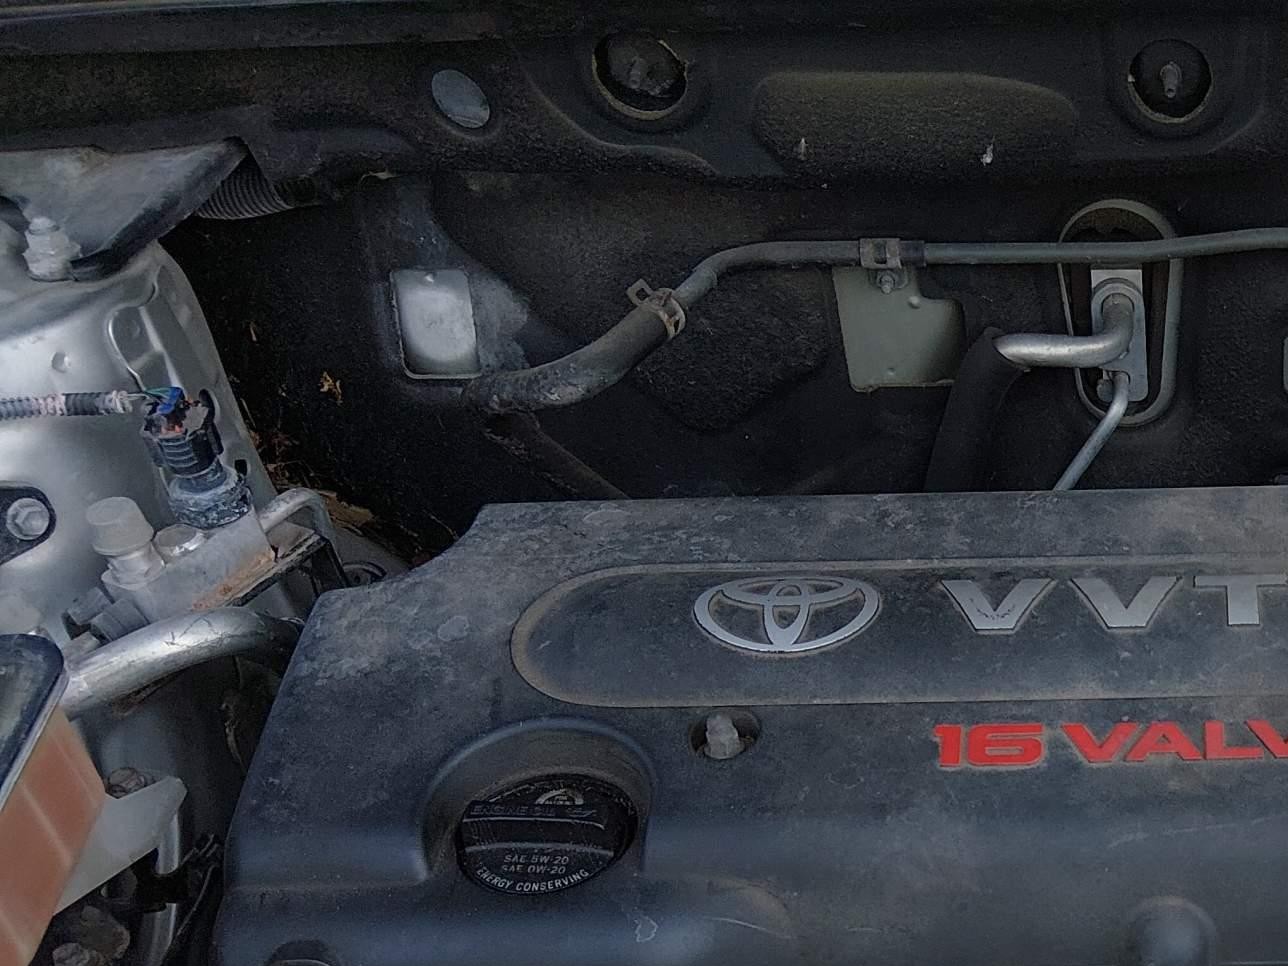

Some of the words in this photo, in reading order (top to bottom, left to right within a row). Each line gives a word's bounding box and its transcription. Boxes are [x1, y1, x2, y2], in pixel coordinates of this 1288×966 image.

[934, 723, 1045, 766] 16
[503, 854, 527, 864] SAE
[530, 855, 569, 865] 5W-20
[515, 869, 590, 892] CONSERVING
